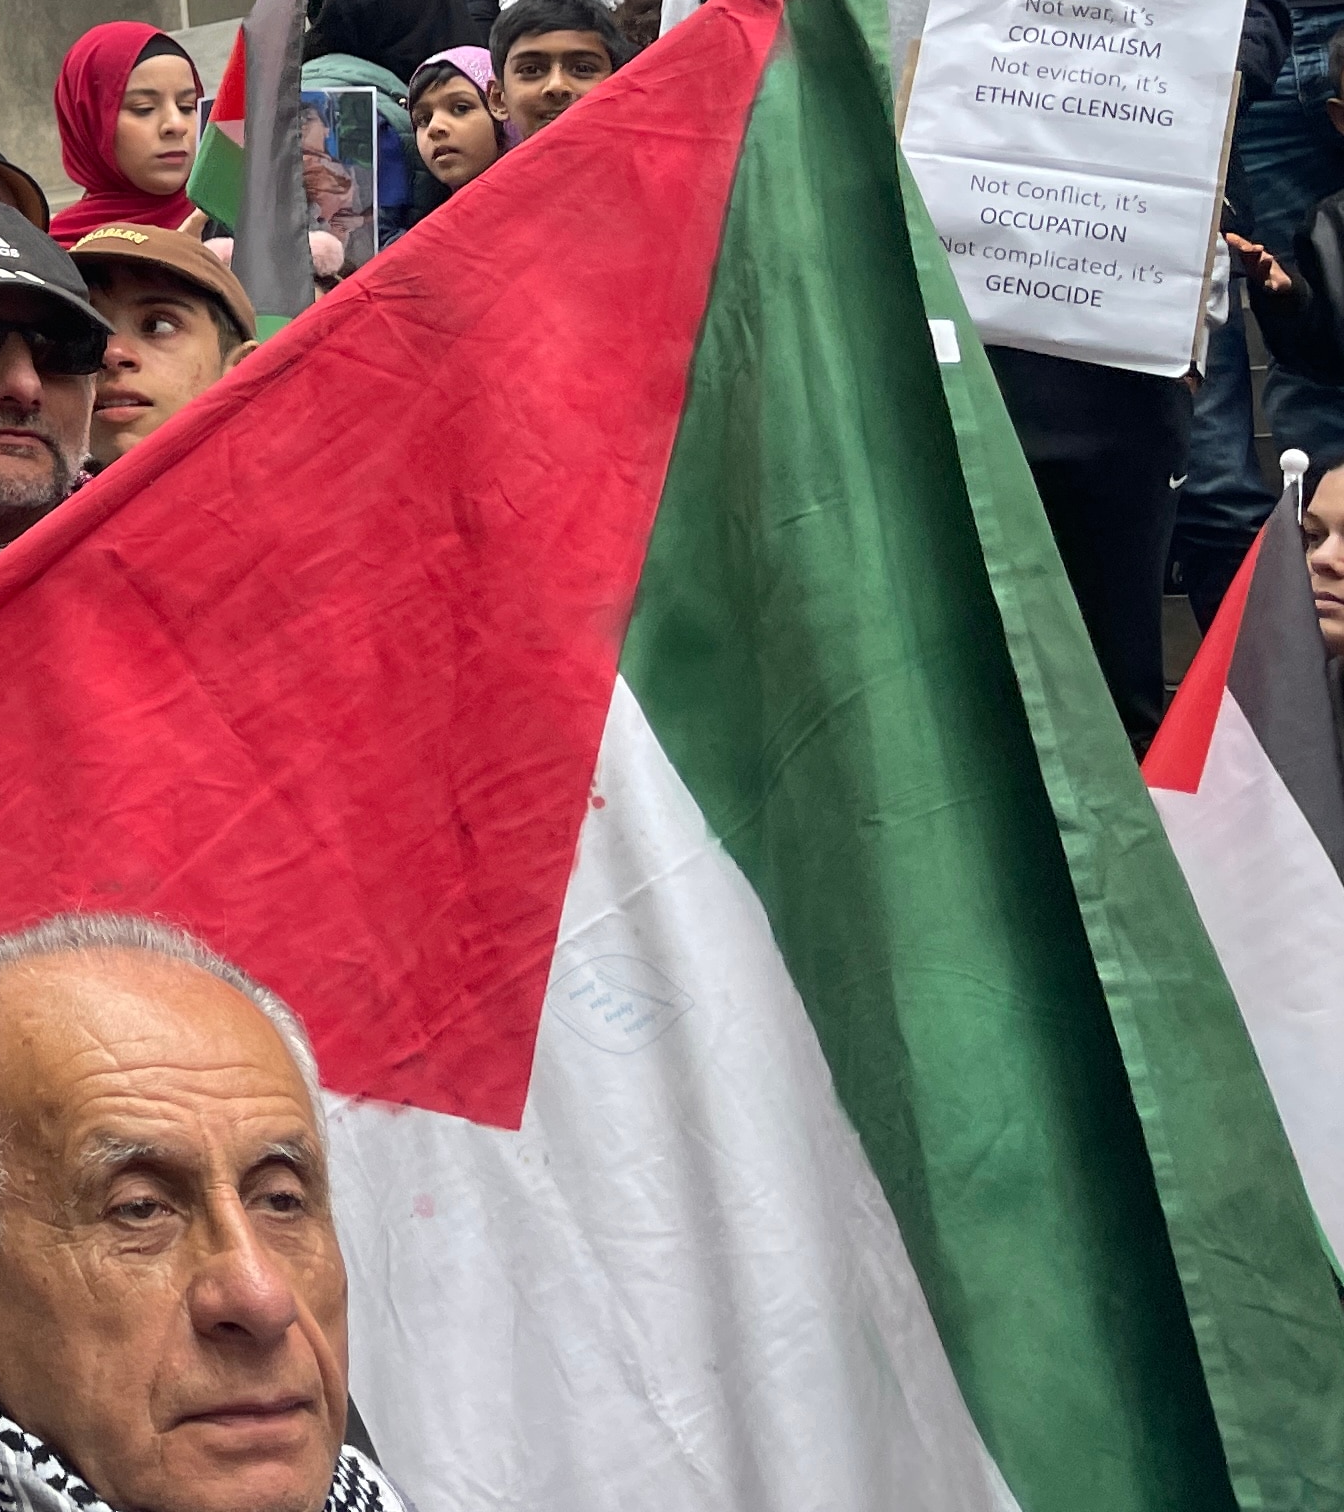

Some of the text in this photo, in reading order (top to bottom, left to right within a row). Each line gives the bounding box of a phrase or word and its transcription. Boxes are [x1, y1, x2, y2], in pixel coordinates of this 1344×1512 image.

[1123, 5, 1155, 27] it's
[1008, 25, 1162, 59] COLONIALISM
[990, 55, 1169, 95] Not eviction, it's
[975, 84, 1175, 128] ETHNIC CLENSING
[970, 174, 1148, 214] Not Conflict, it's
[980, 207, 1128, 244] OCCUPATION
[982, 244, 1123, 281] complicated,
[1131, 262, 1164, 285] it's
[985, 274, 1105, 308] GENOCIDE
